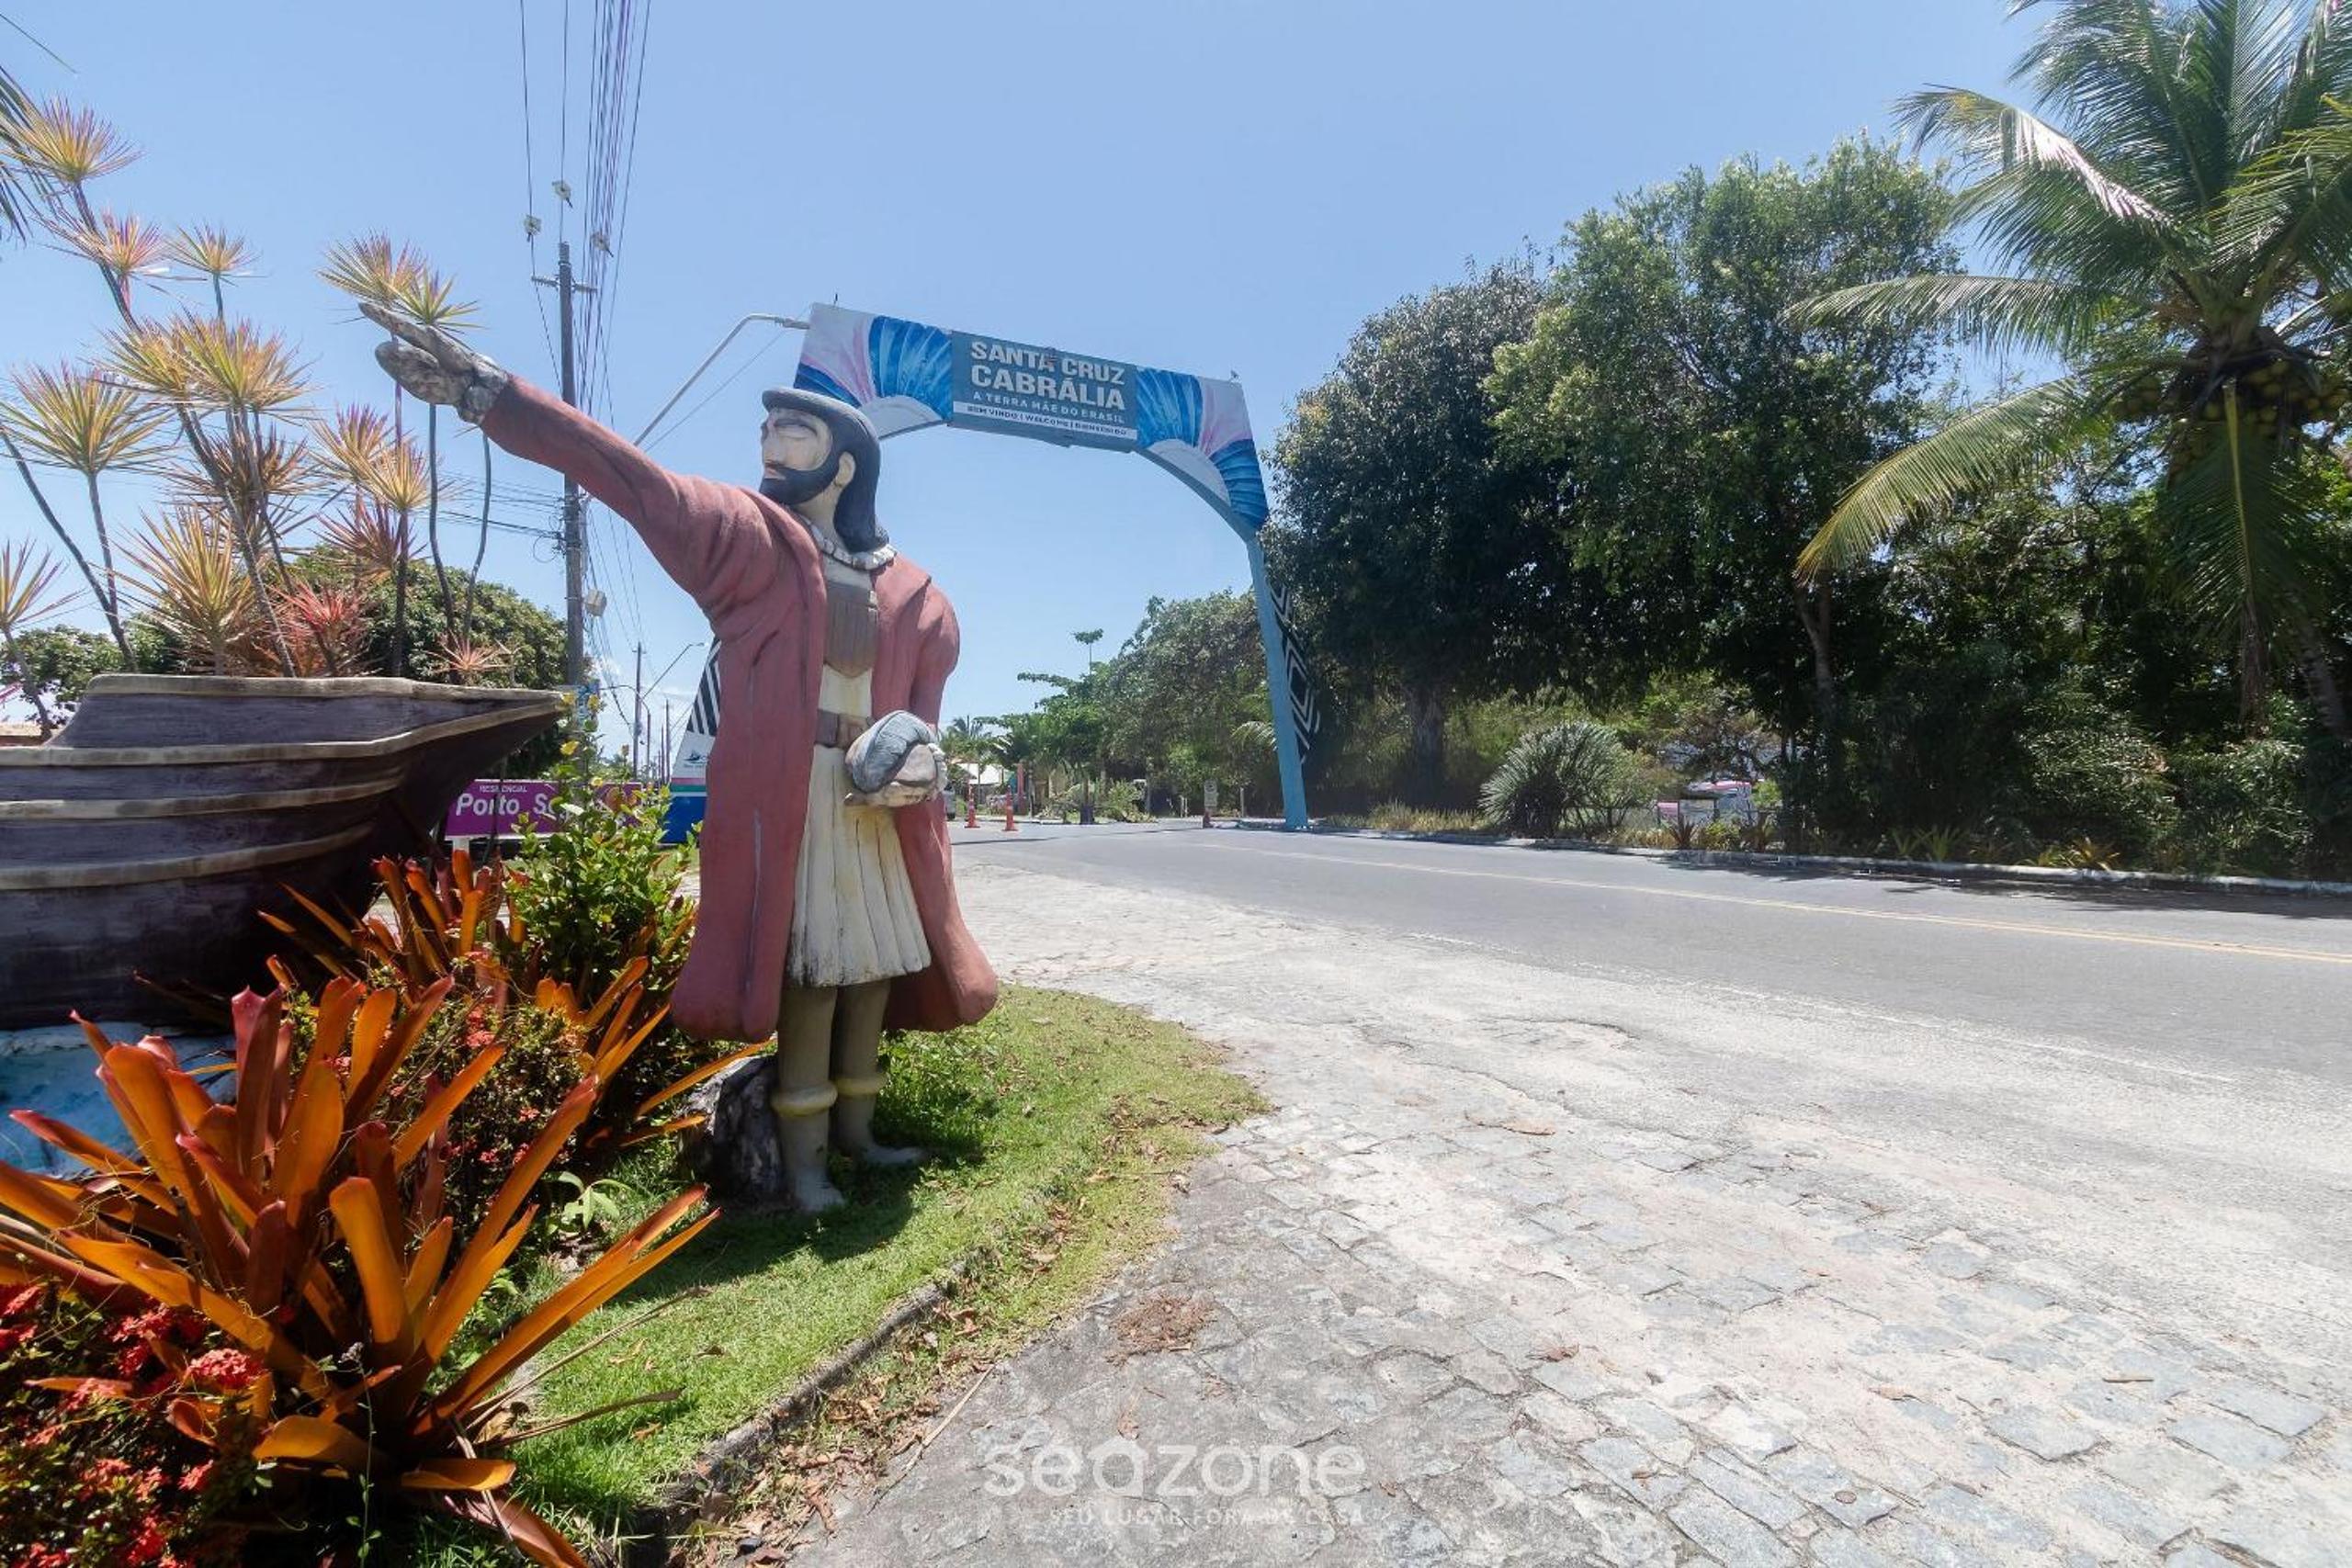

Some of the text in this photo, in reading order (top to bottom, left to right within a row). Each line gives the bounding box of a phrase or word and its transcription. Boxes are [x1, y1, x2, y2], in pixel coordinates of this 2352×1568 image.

[971, 341, 1125, 385] SANTA CRUZ
[971, 365, 1125, 410] CABRÁLIA
[973, 391, 1125, 423] A TERRA MÃE DO BRASIL
[456, 793, 520, 817] Porto
